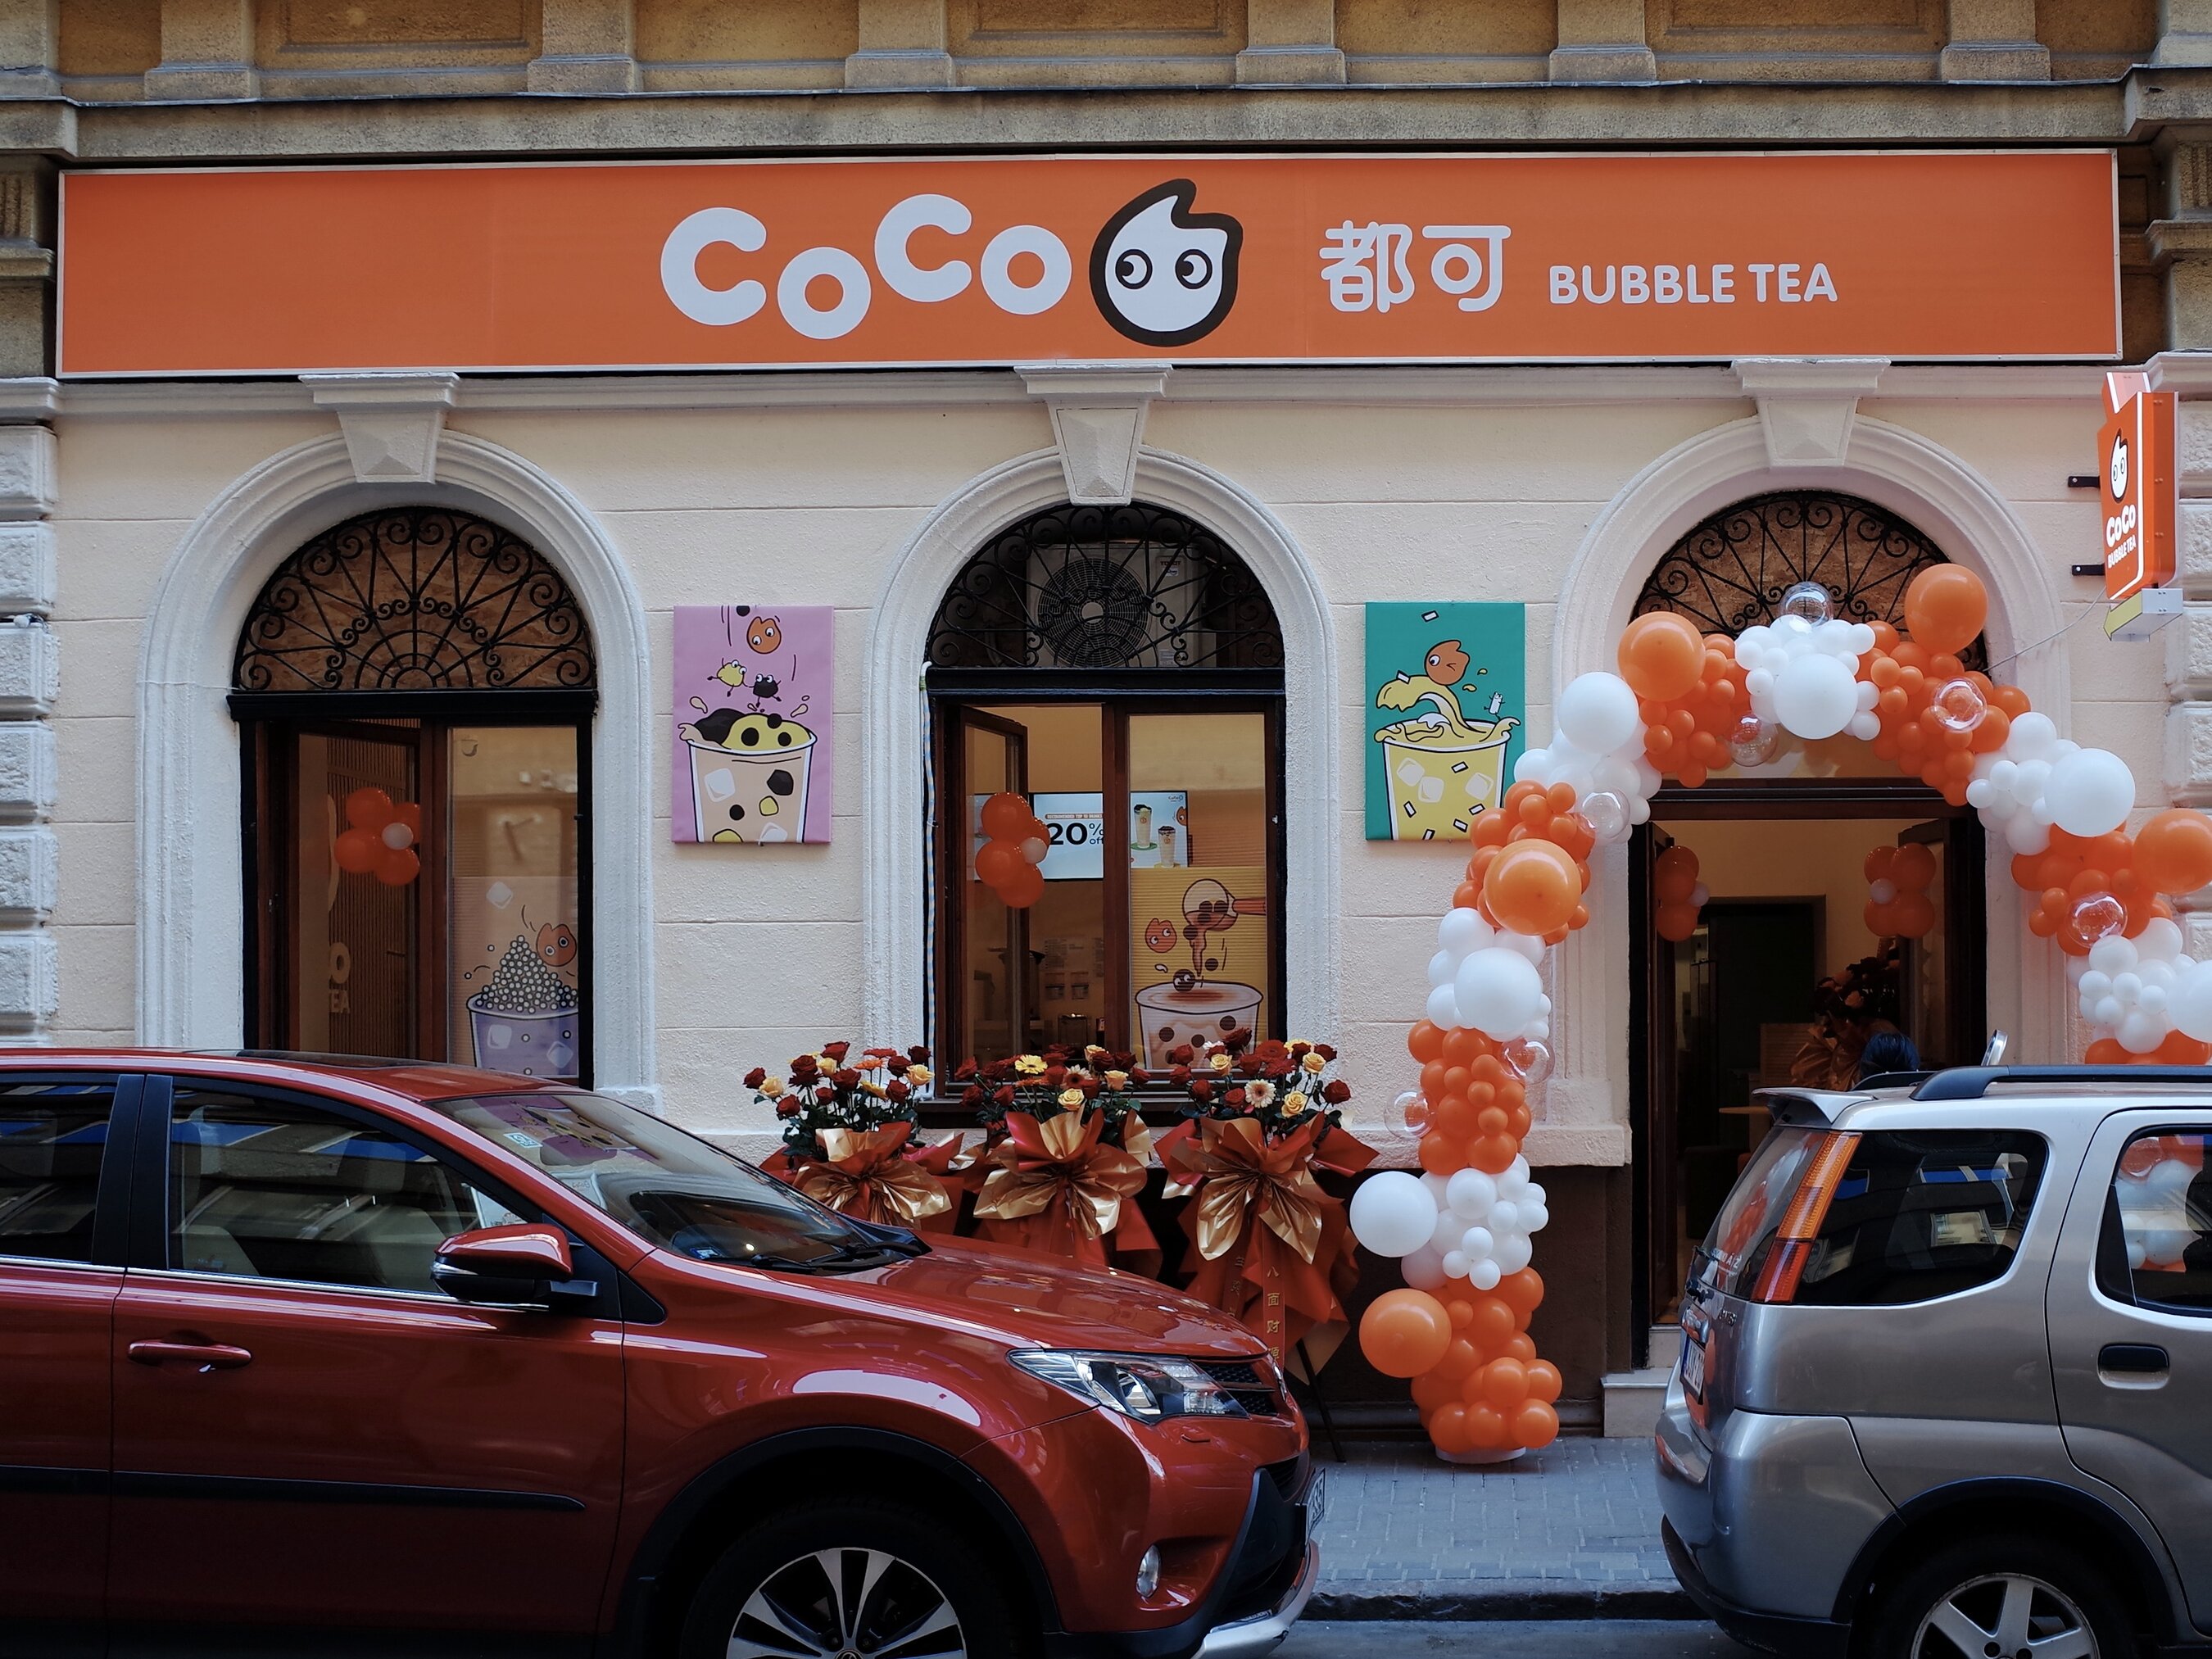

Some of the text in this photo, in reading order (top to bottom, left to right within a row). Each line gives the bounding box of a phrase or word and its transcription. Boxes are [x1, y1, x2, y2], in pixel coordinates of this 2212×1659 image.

[660, 193, 1072, 340] CoCo
[1319, 220, 1512, 313] 都可
[1549, 263, 1838, 305] BUBBLE TEA
[2108, 534, 2137, 569] BUBBLE TEA
